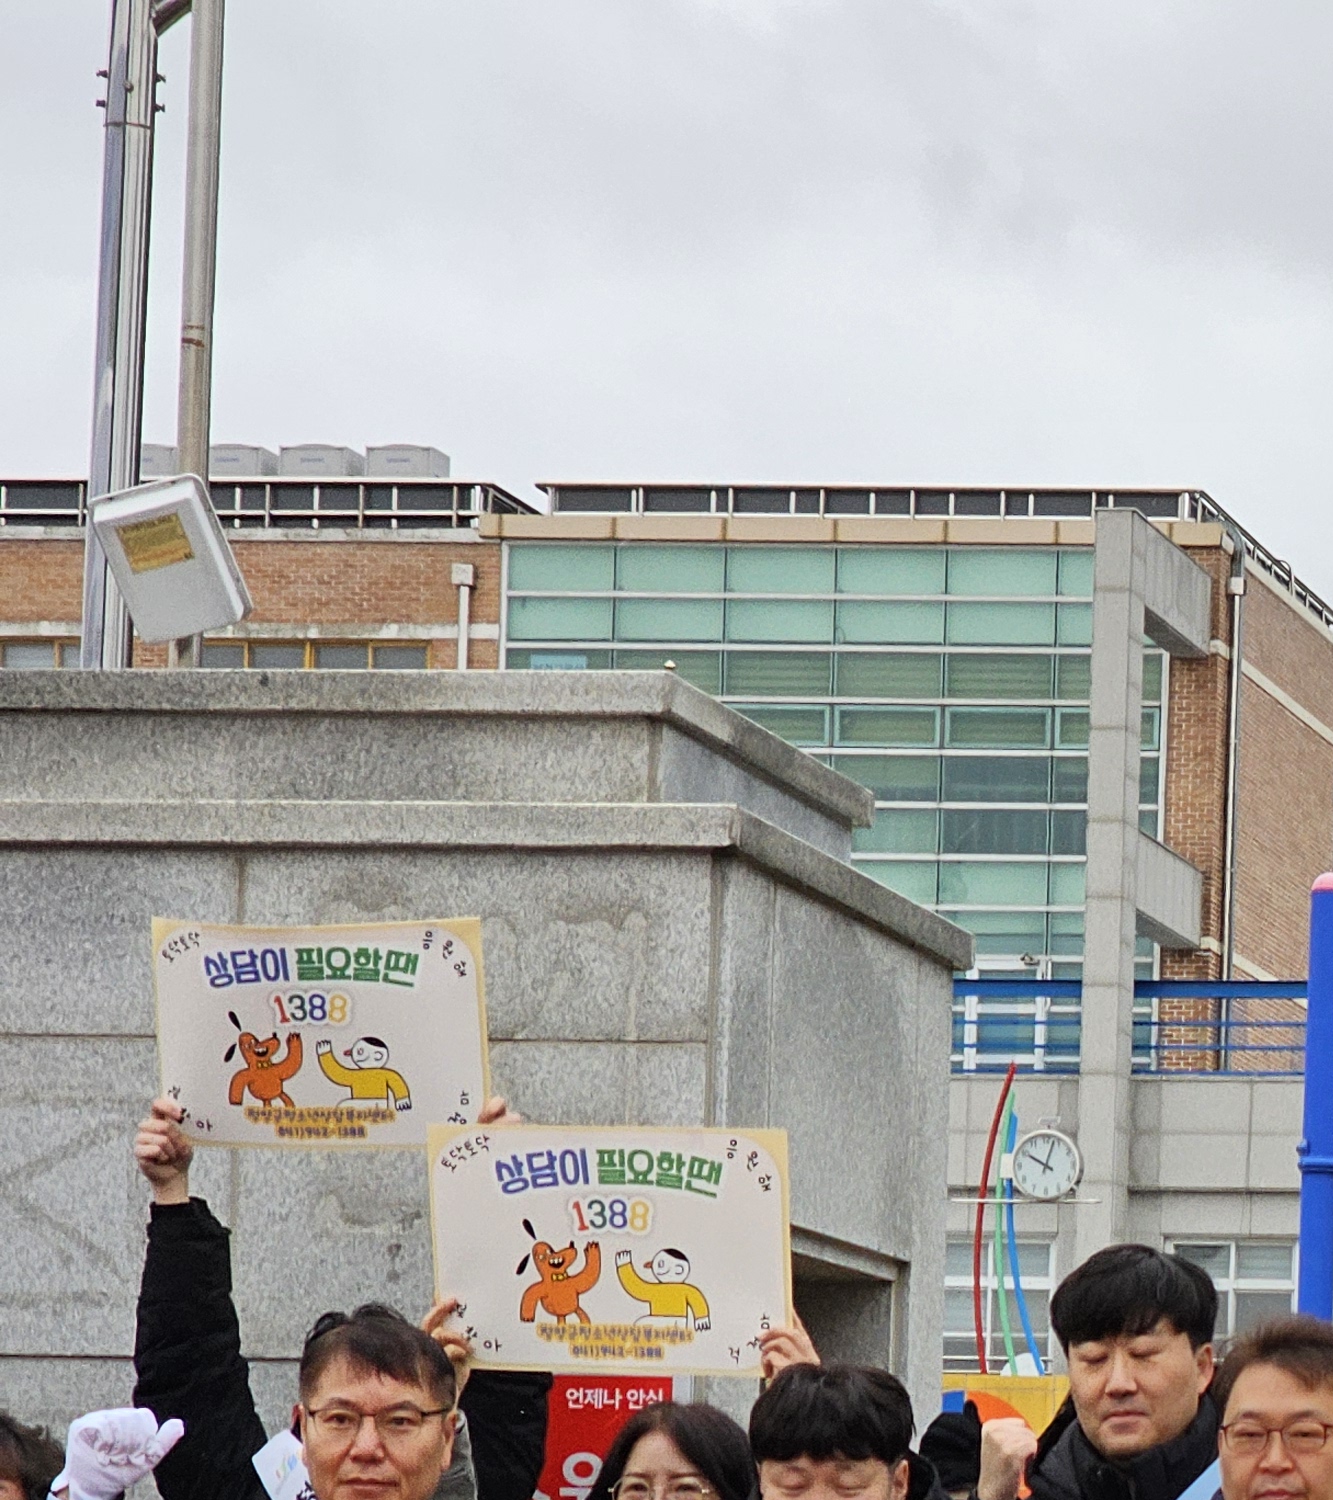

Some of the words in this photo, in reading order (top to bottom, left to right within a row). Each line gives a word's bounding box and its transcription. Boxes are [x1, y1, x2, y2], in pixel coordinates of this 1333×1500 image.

[203, 947, 290, 988] 상담이
[295, 946, 419, 988] 필요할땐
[273, 994, 348, 1025] 1388
[495, 1148, 590, 1195] 상담이
[596, 1148, 723, 1199] 필요할땐
[572, 1199, 651, 1233] 1388
[565, 1388, 623, 1410] 언제나
